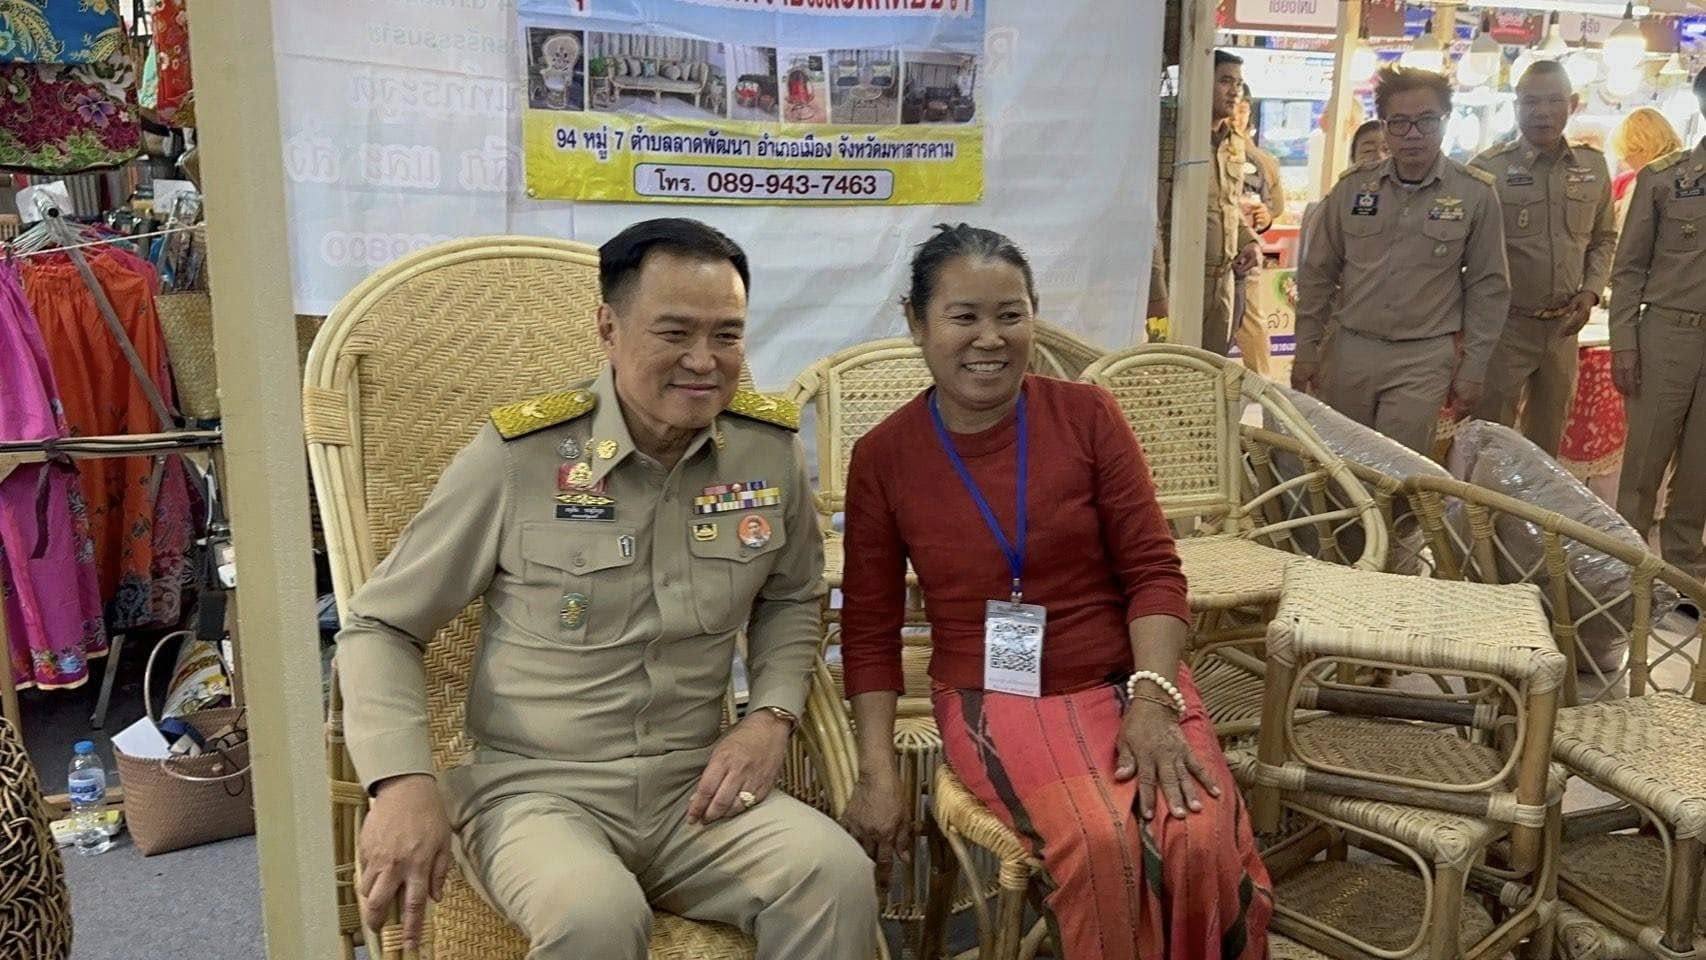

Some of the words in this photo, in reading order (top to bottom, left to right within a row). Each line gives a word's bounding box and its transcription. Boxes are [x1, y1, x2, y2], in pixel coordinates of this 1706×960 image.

[556, 129, 577, 148] 94
[583, 126, 608, 160] หมู่
[614, 131, 624, 150] 7
[631, 126, 751, 156] ตำบลลาดพัฒนา
[757, 133, 832, 159] อำเภอเมือง
[838, 136, 955, 160] จังหวัดมหาสารคาม
[654, 168, 696, 191] โทร.
[707, 172, 877, 195] 089-943-7463
